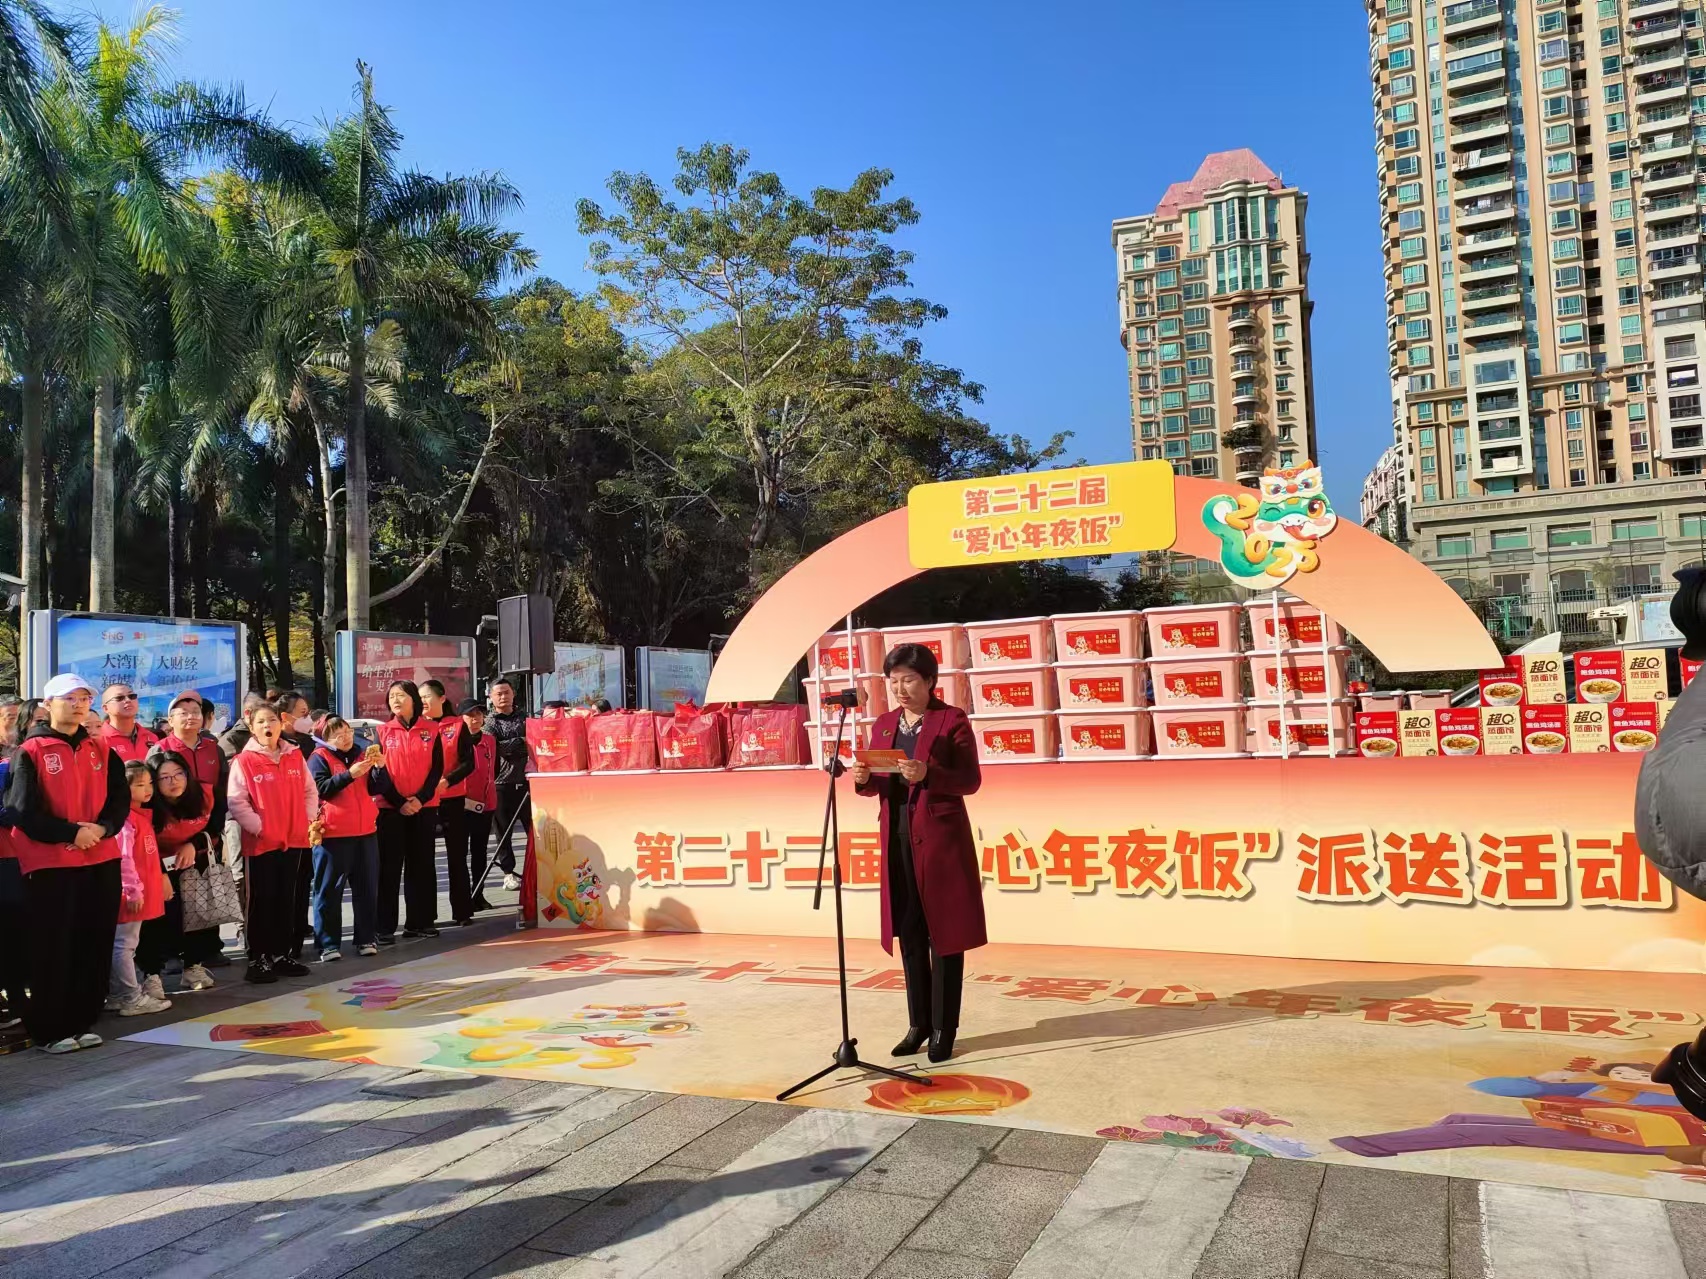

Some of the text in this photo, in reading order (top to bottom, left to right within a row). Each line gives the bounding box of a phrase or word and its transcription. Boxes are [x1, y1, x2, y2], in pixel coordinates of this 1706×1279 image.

[965, 477, 1105, 516] 第二十二届
[953, 515, 1120, 553] “爱心年夜饭”
[102, 653, 198, 670] 大湾区 大财经
[634, 829, 1661, 902] 第二十二届心年夜饭”派送活动
